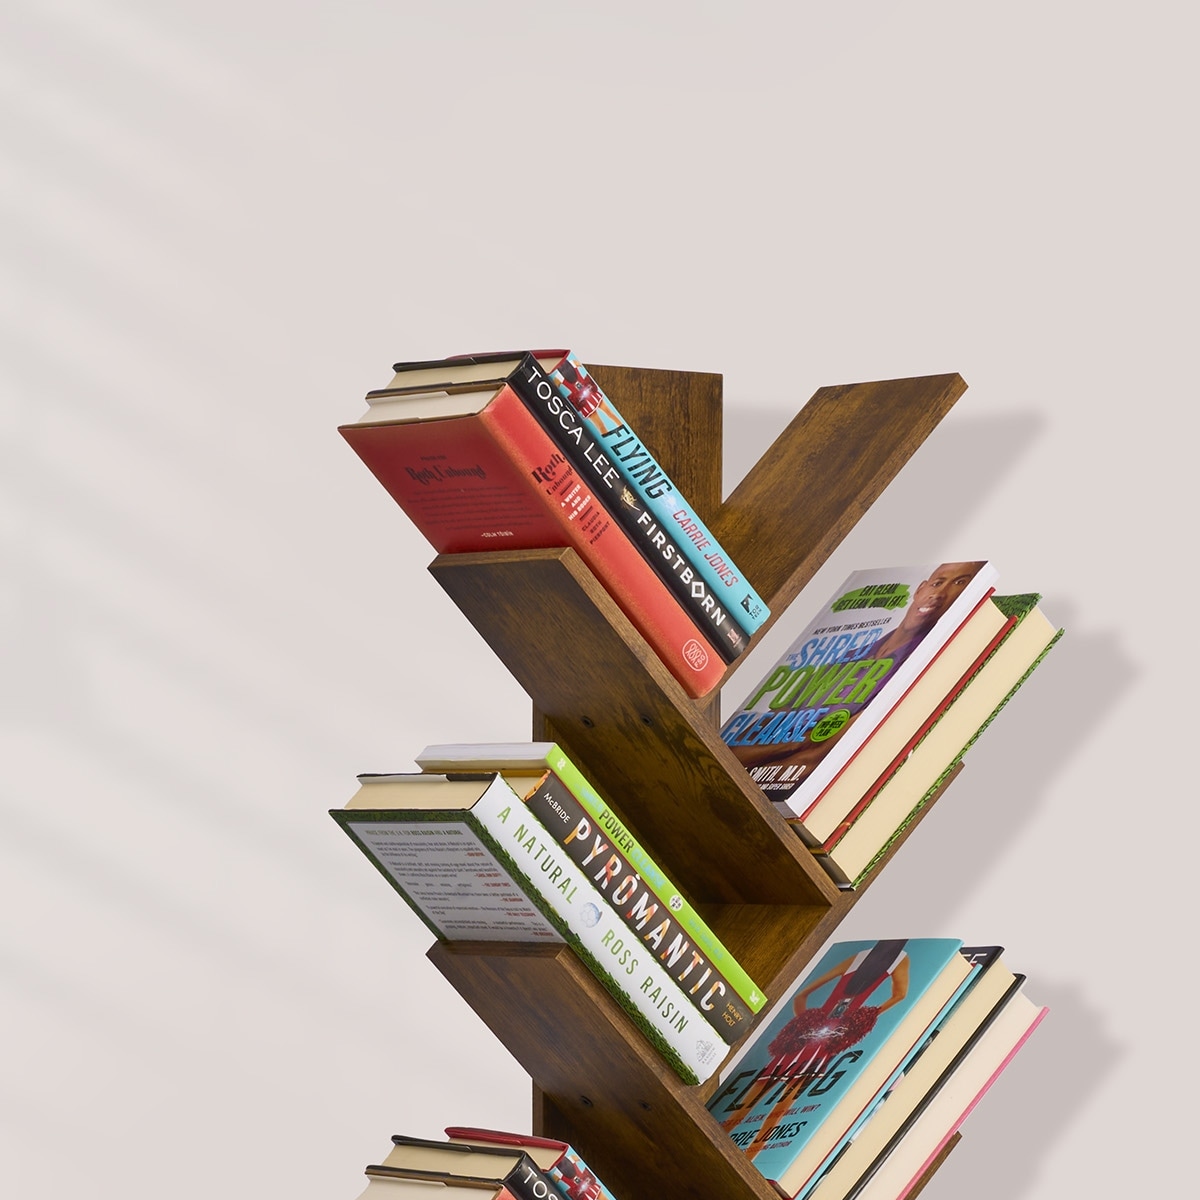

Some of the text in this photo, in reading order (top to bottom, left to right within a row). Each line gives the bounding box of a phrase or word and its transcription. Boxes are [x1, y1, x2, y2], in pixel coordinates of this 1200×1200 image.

[527, 366, 620, 489] TOSCA LEE
[601, 424, 673, 500] FLYING
[637, 512, 726, 626] FIRSTBORN
[672, 509, 739, 587] CARRIE JONES
[790, 628, 882, 671] SHRED
[744, 658, 893, 710] POWER
[543, 793, 571, 824] McBRIDE
[599, 810, 634, 853] POWER
[497, 807, 511, 824] A
[513, 824, 577, 904] NATURAL
[564, 817, 726, 1011] PYROMANTIC
[601, 929, 689, 1034] ROSS RAISIN
[727, 1003, 744, 1022] HENRY
[722, 1012, 736, 1027] HOLT
[705, 1050, 863, 1113] FLYING
[753, 1121, 808, 1143] JONES
